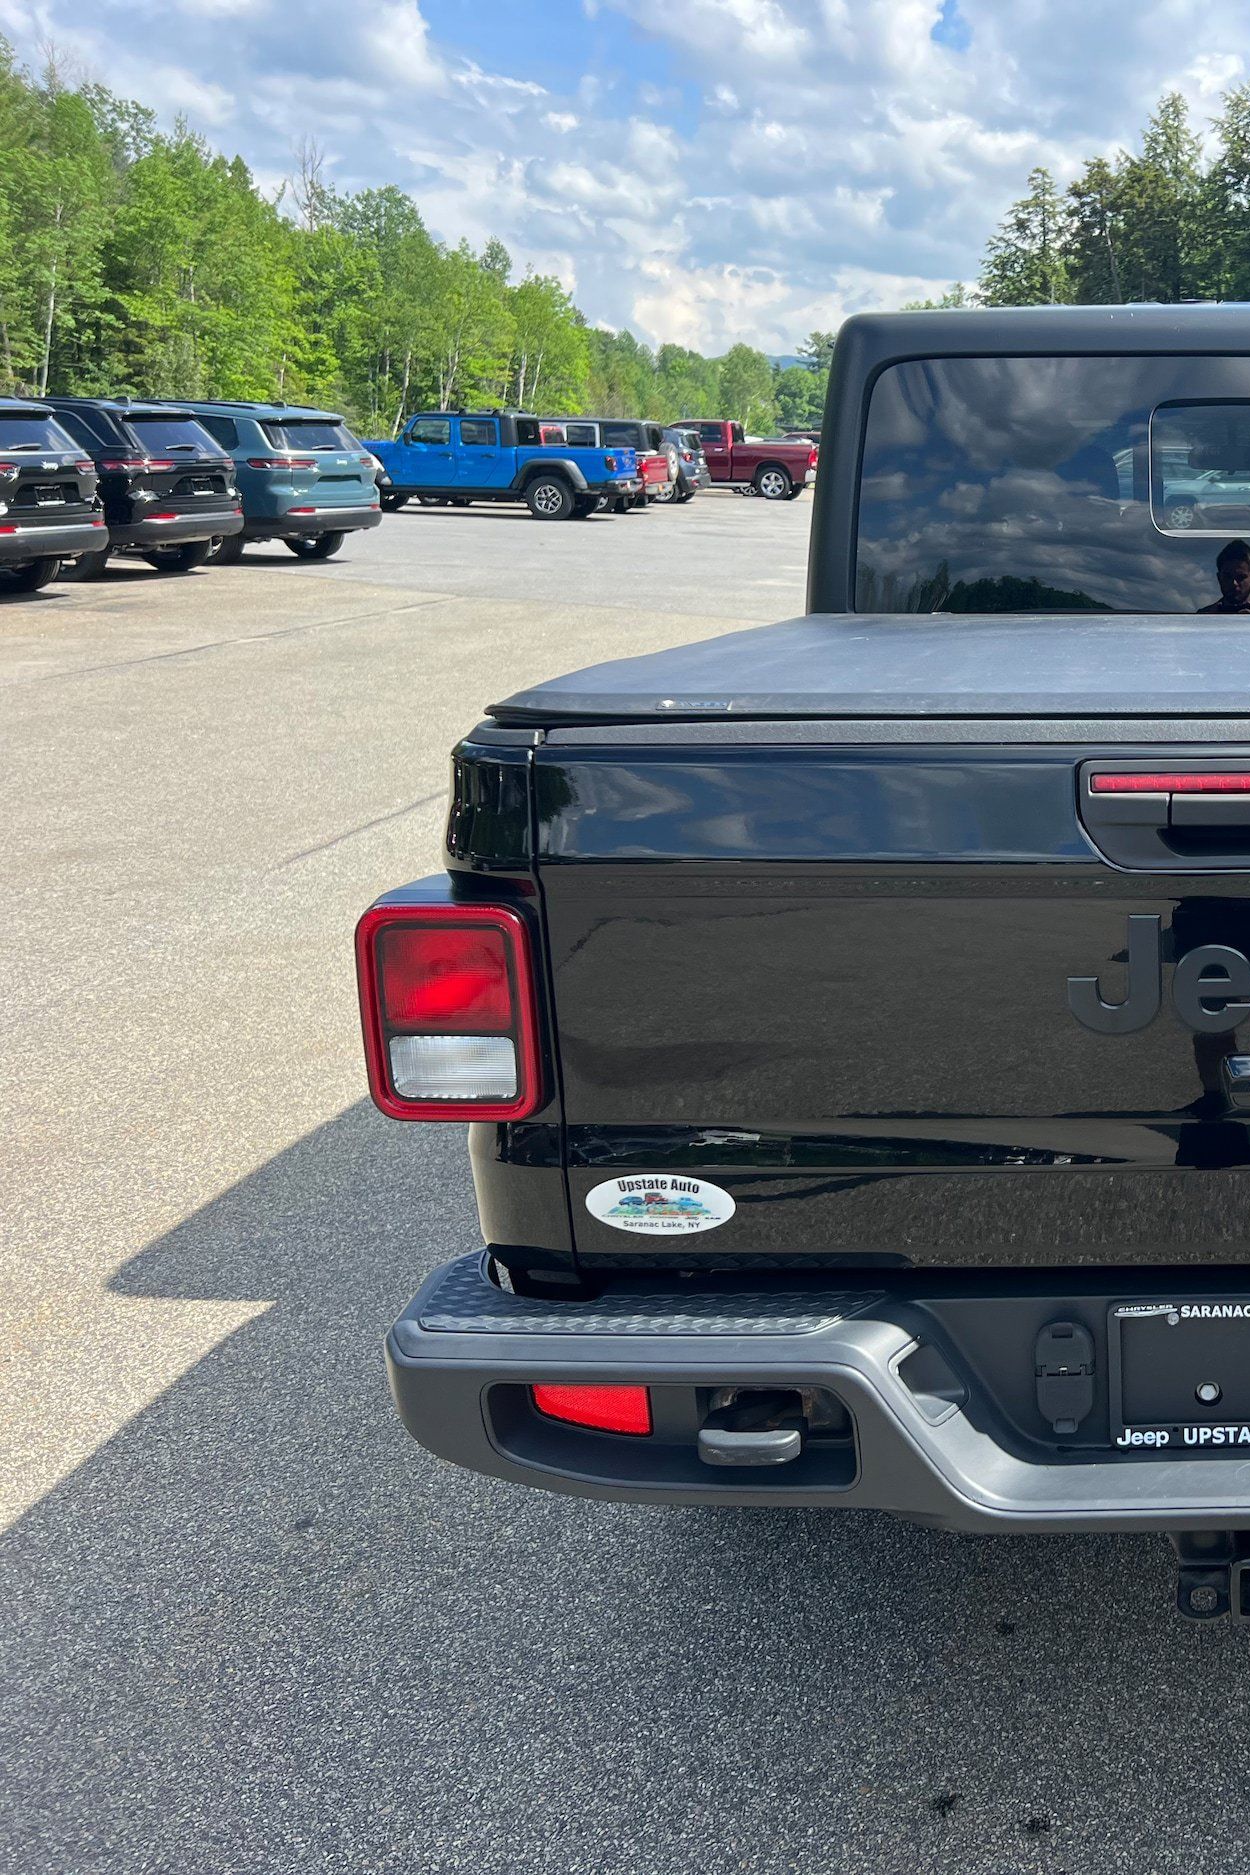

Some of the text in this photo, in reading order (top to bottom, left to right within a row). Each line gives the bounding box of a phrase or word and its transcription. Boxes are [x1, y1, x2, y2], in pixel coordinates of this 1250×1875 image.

[617, 1178, 700, 1194] Upstate Auto
[623, 1220, 659, 1228] Saranac
[661, 1221, 685, 1229] Lake,
[1118, 1304, 1173, 1312] CHRYSLER
[1116, 1428, 1170, 1447] Jeep
